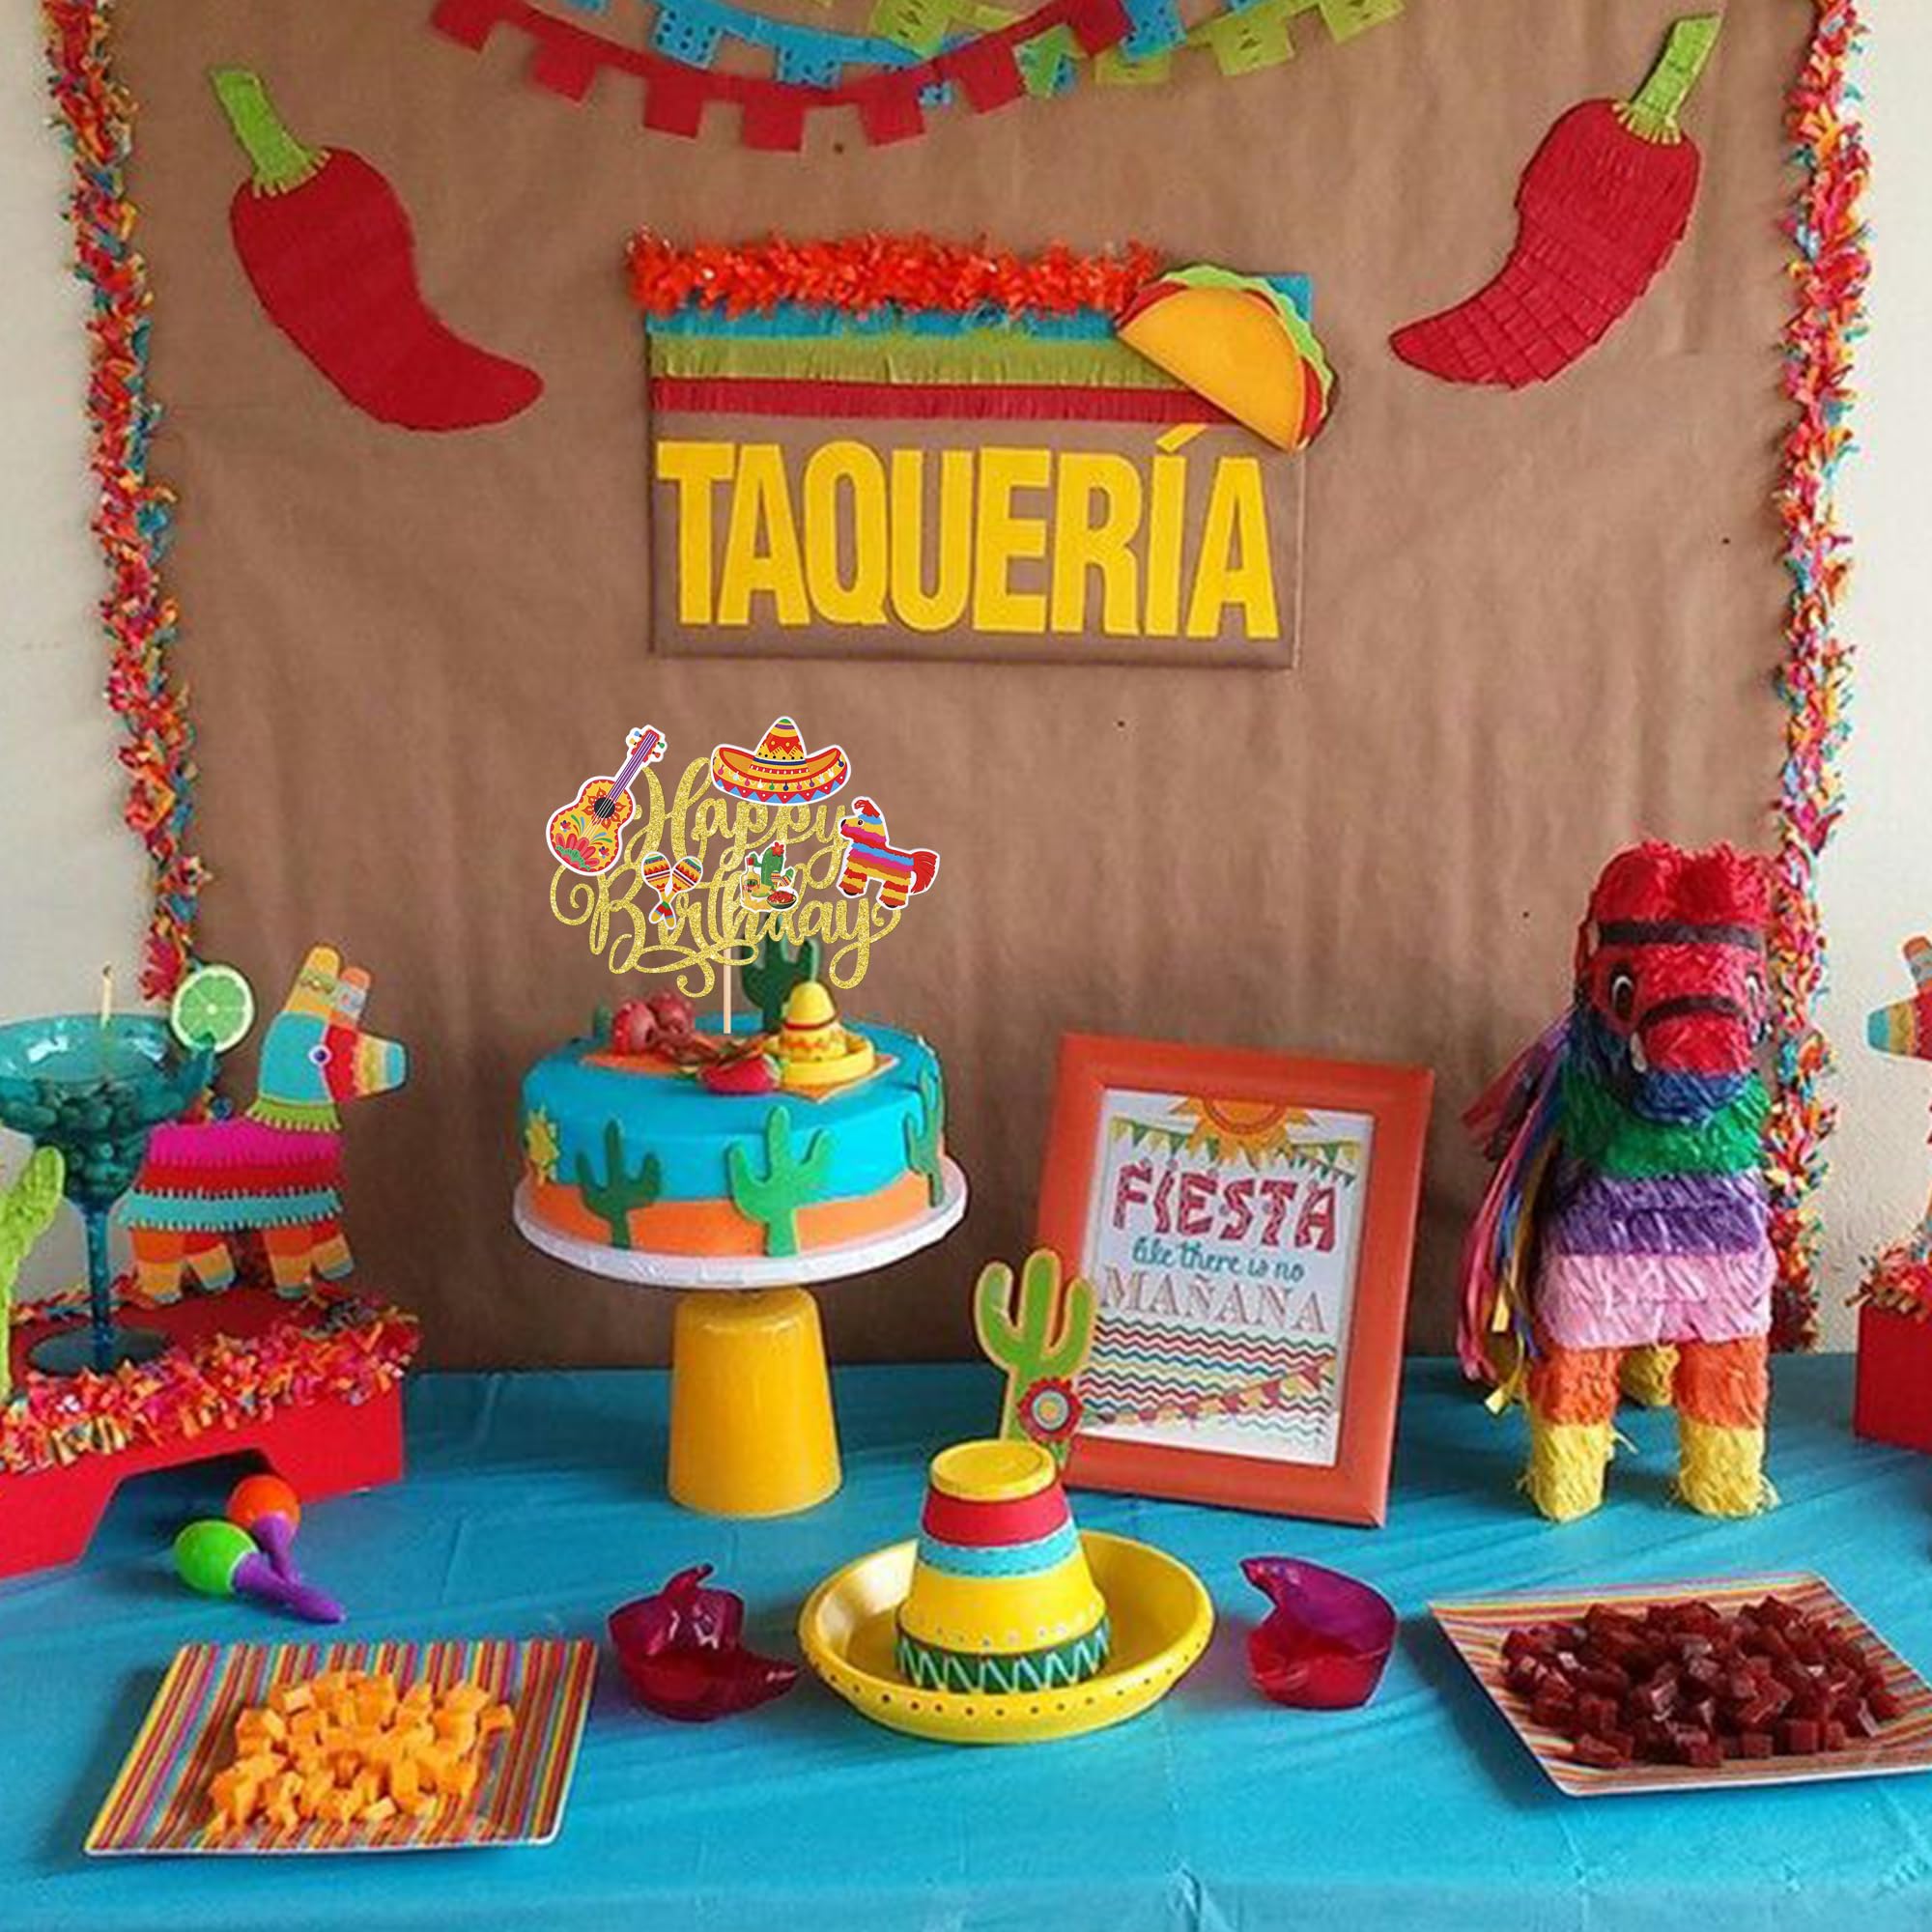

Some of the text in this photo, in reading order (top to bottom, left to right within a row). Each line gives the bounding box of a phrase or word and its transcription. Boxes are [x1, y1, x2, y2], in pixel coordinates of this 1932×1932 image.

[657, 423, 1280, 639] TAQUERÍA
[623, 756, 848, 890] Happy
[1113, 1159, 1337, 1253] FIESTA
[1100, 1265, 1328, 1333] MAÑANA
[1131, 1236, 1306, 1283] like there is no
